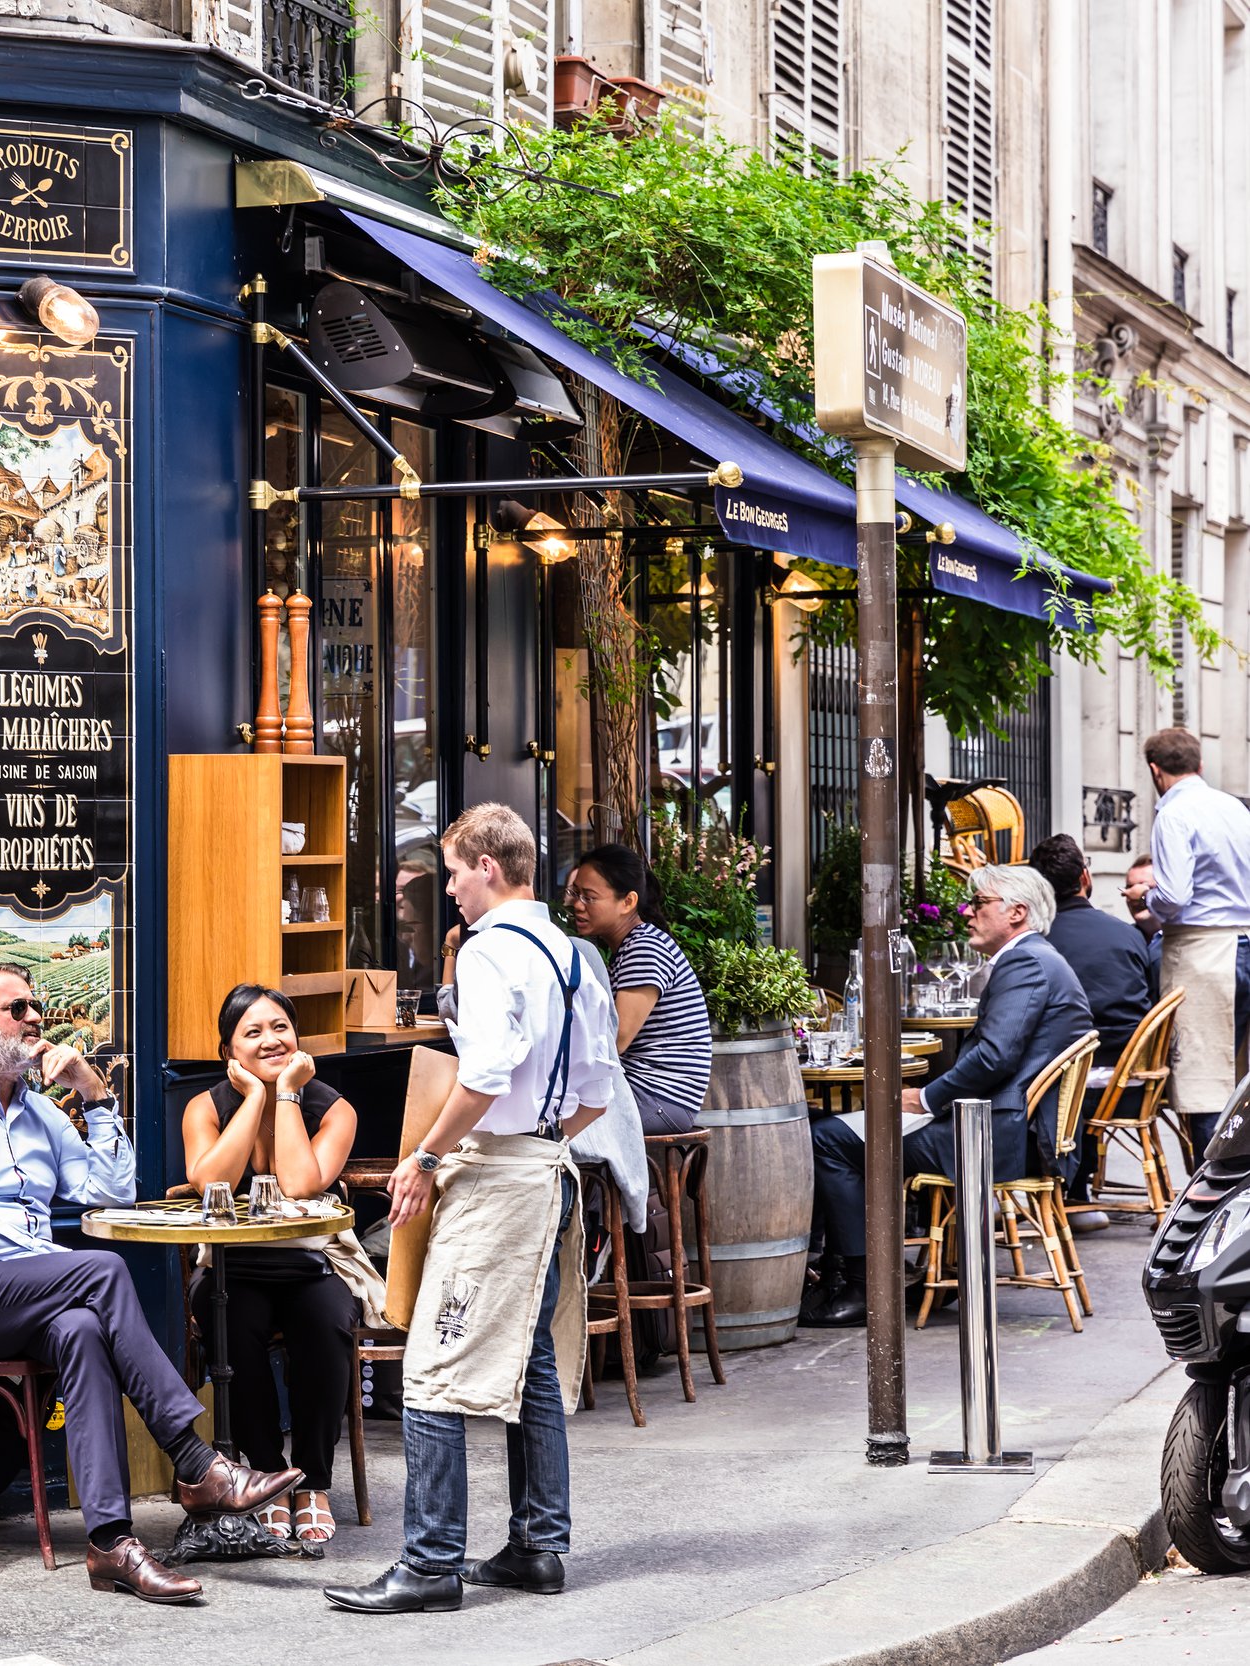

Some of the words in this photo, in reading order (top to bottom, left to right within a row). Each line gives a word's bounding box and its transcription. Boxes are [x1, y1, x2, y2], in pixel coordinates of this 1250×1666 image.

[881, 292, 907, 332] Musée
[909, 309, 938, 351] National
[882, 337, 911, 379] Gustave
[913, 356, 942, 396] MOREAU
[726, 499, 739, 520] LE
[740, 501, 754, 523] BON
[755, 506, 789, 533] GEORGES
[937, 553, 945, 571] LE
[945, 558, 955, 575] BON
[955, 561, 977, 583] GEORGES
[1, 711, 113, 752] MARAÎCHERS
[35, 764, 50, 780] DE
[57, 765, 97, 781] SAISON
[4, 793, 46, 828] VINS
[54, 793, 79, 828] DE
